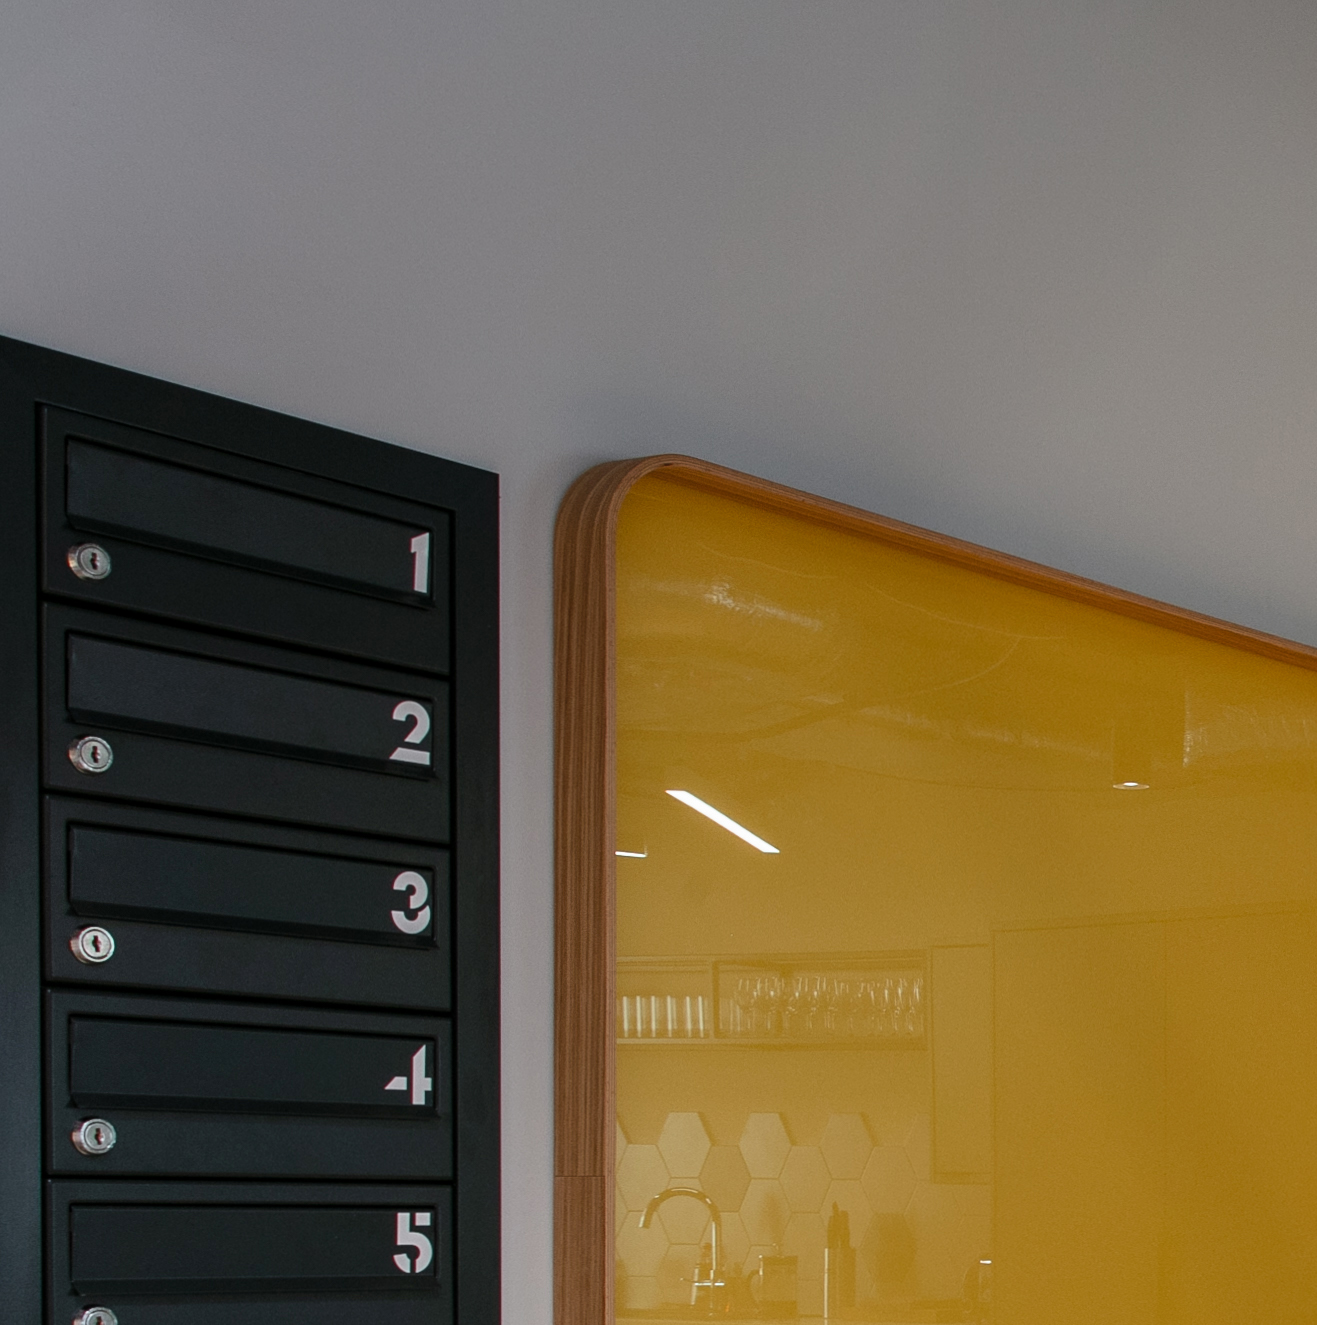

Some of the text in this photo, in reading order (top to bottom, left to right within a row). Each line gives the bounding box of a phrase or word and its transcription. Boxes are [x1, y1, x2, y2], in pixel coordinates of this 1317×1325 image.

[411, 533, 429, 593] 1
[390, 701, 430, 765] 2
[391, 871, 430, 934] 3
[385, 1045, 432, 1105] 4
[393, 1212, 432, 1273] 5
